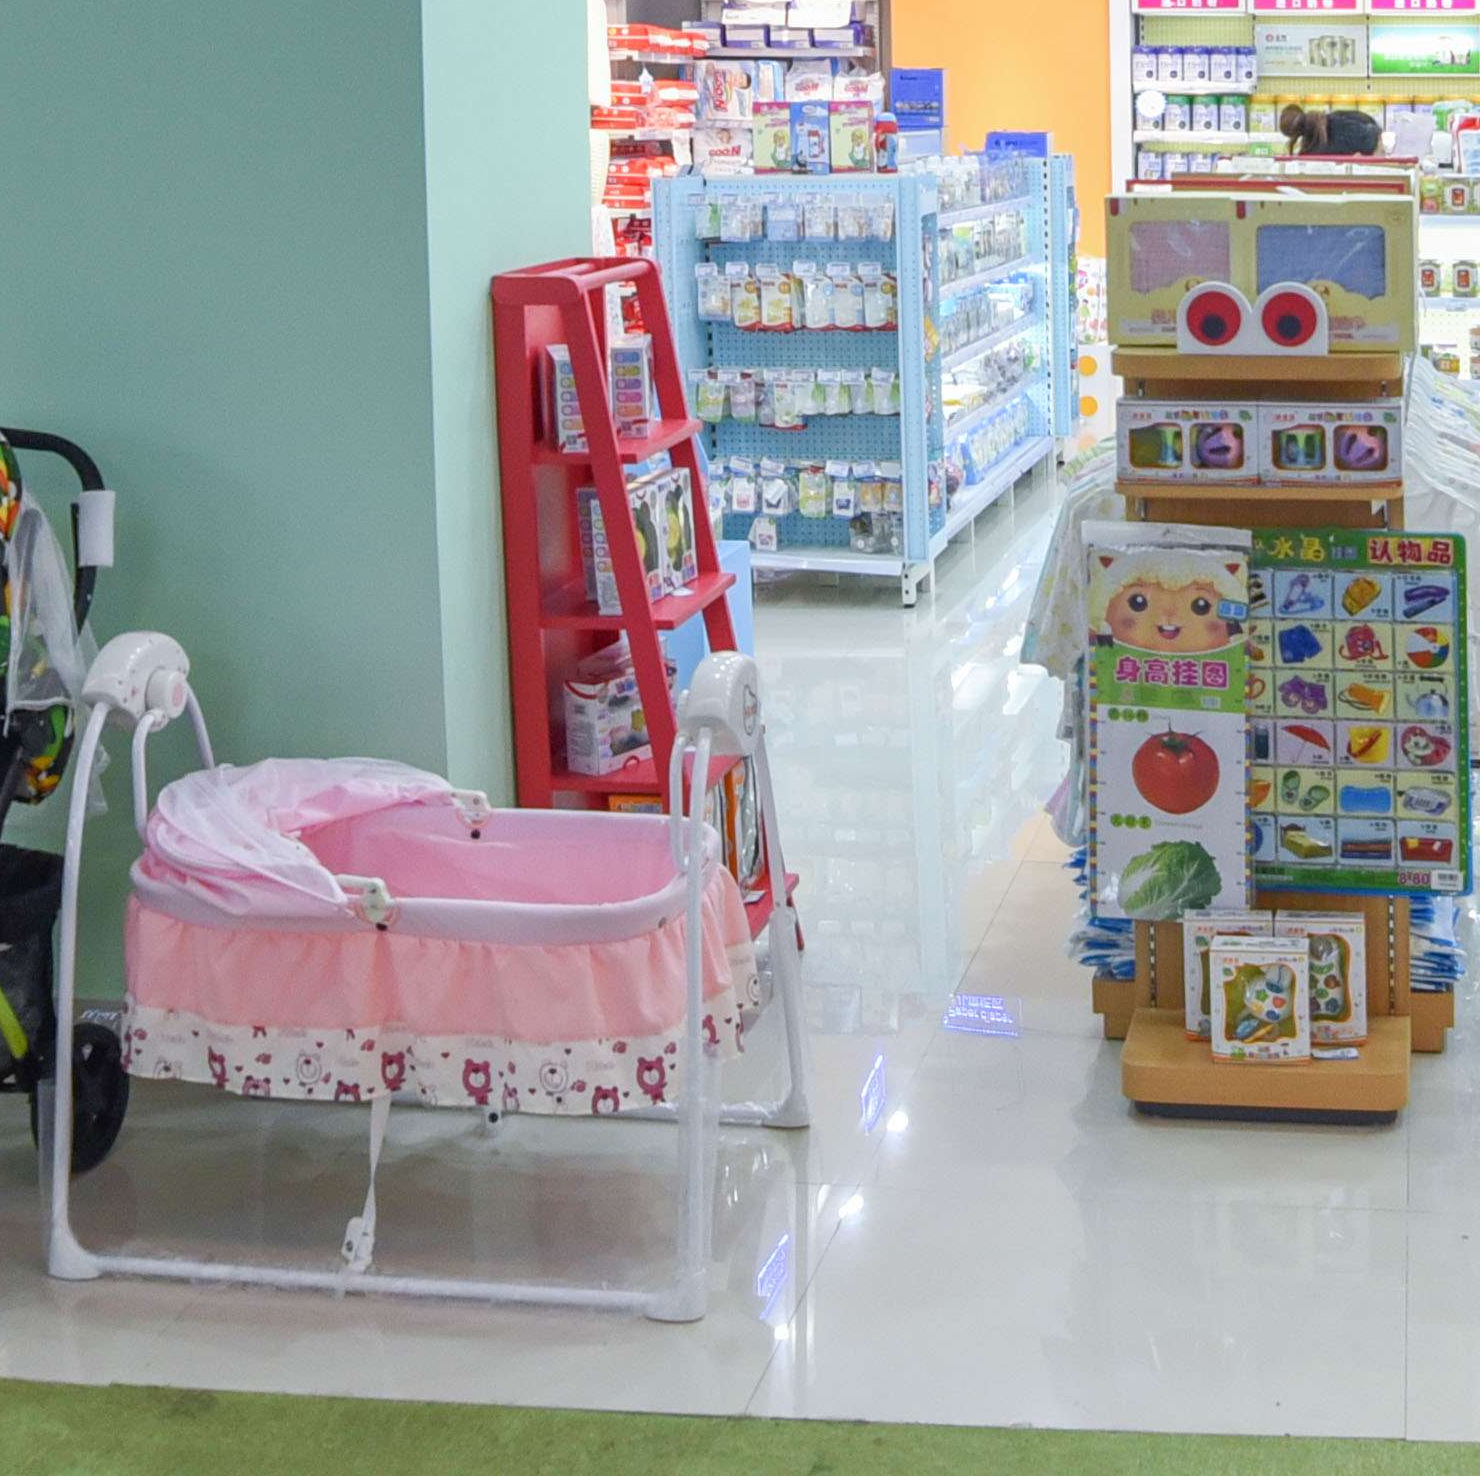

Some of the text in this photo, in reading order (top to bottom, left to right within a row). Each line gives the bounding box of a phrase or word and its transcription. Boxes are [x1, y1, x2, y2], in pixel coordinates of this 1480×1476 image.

[1369, 537, 1454, 566] 认物品
[1115, 655, 1229, 690] 身高挂图
